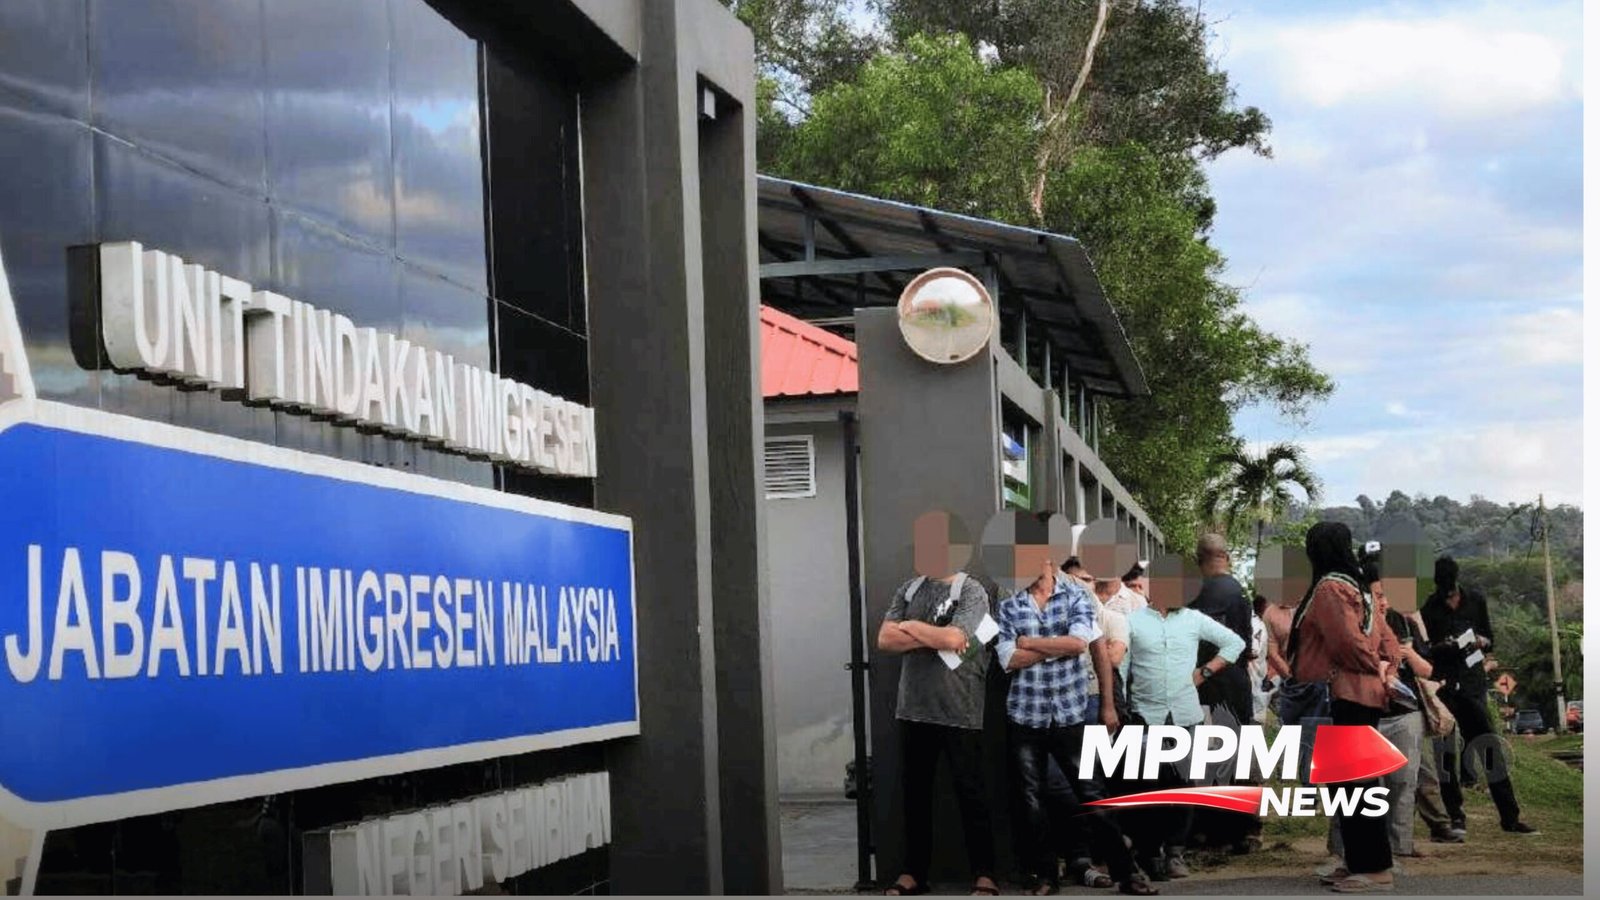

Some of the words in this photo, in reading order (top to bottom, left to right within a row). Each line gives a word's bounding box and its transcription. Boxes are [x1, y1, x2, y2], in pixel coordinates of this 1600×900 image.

[130, 241, 252, 388] UNIT
[262, 290, 456, 441] TINDAKAN
[464, 363, 597, 477] IMIGRESEN
[5, 544, 283, 683] JABATAN
[297, 567, 495, 673] IMIGRESEN
[502, 581, 620, 666] MALAYSIA
[354, 799, 483, 896] NEGERI
[489, 771, 611, 883] SEMBILAN
